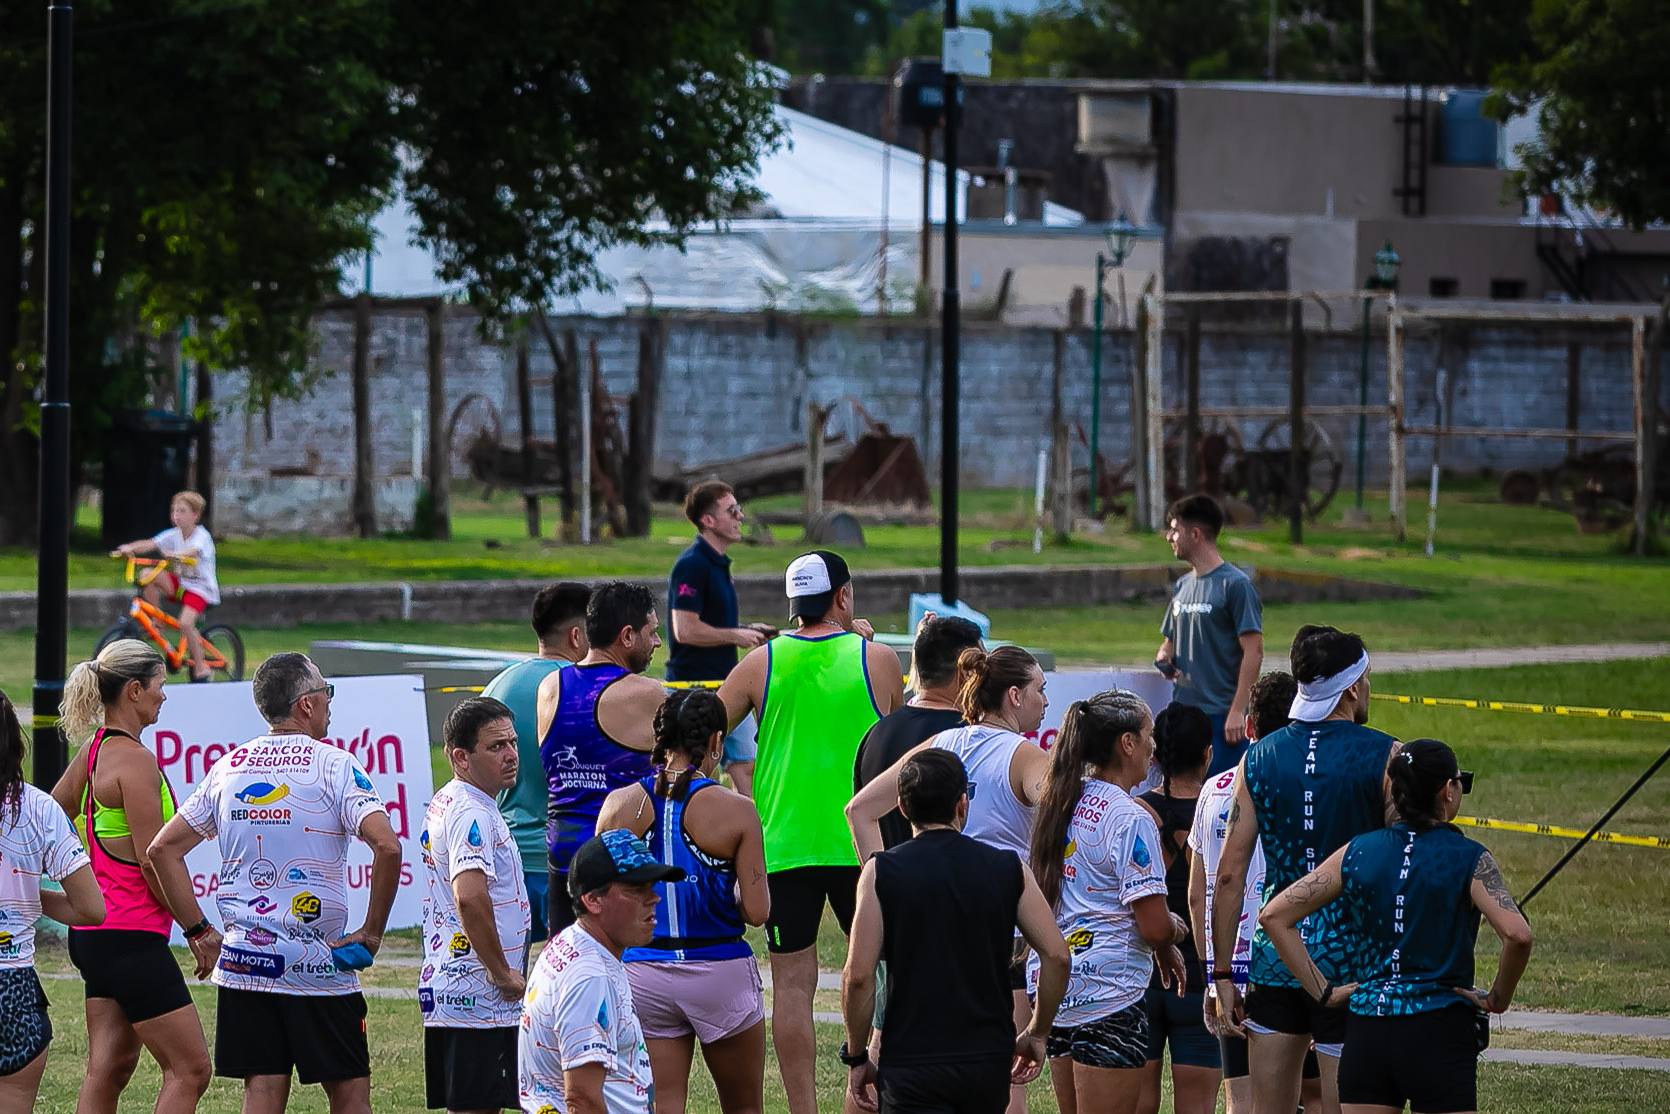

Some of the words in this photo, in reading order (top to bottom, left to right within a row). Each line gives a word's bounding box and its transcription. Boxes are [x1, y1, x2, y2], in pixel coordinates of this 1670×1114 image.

[251, 745, 313, 756] SANCOR
[247, 756, 311, 767] SEGUROS
[559, 771, 606, 781] MARATON
[562, 780, 607, 789] NOCTURNA
[1081, 793, 1109, 812] COR
[231, 809, 291, 821] REDCOLOR
[1072, 805, 1103, 824] UROS
[241, 954, 275, 968] MOTTA
[292, 963, 304, 974] el
[437, 994, 444, 1005] el
[447, 995, 476, 1006] trébol
